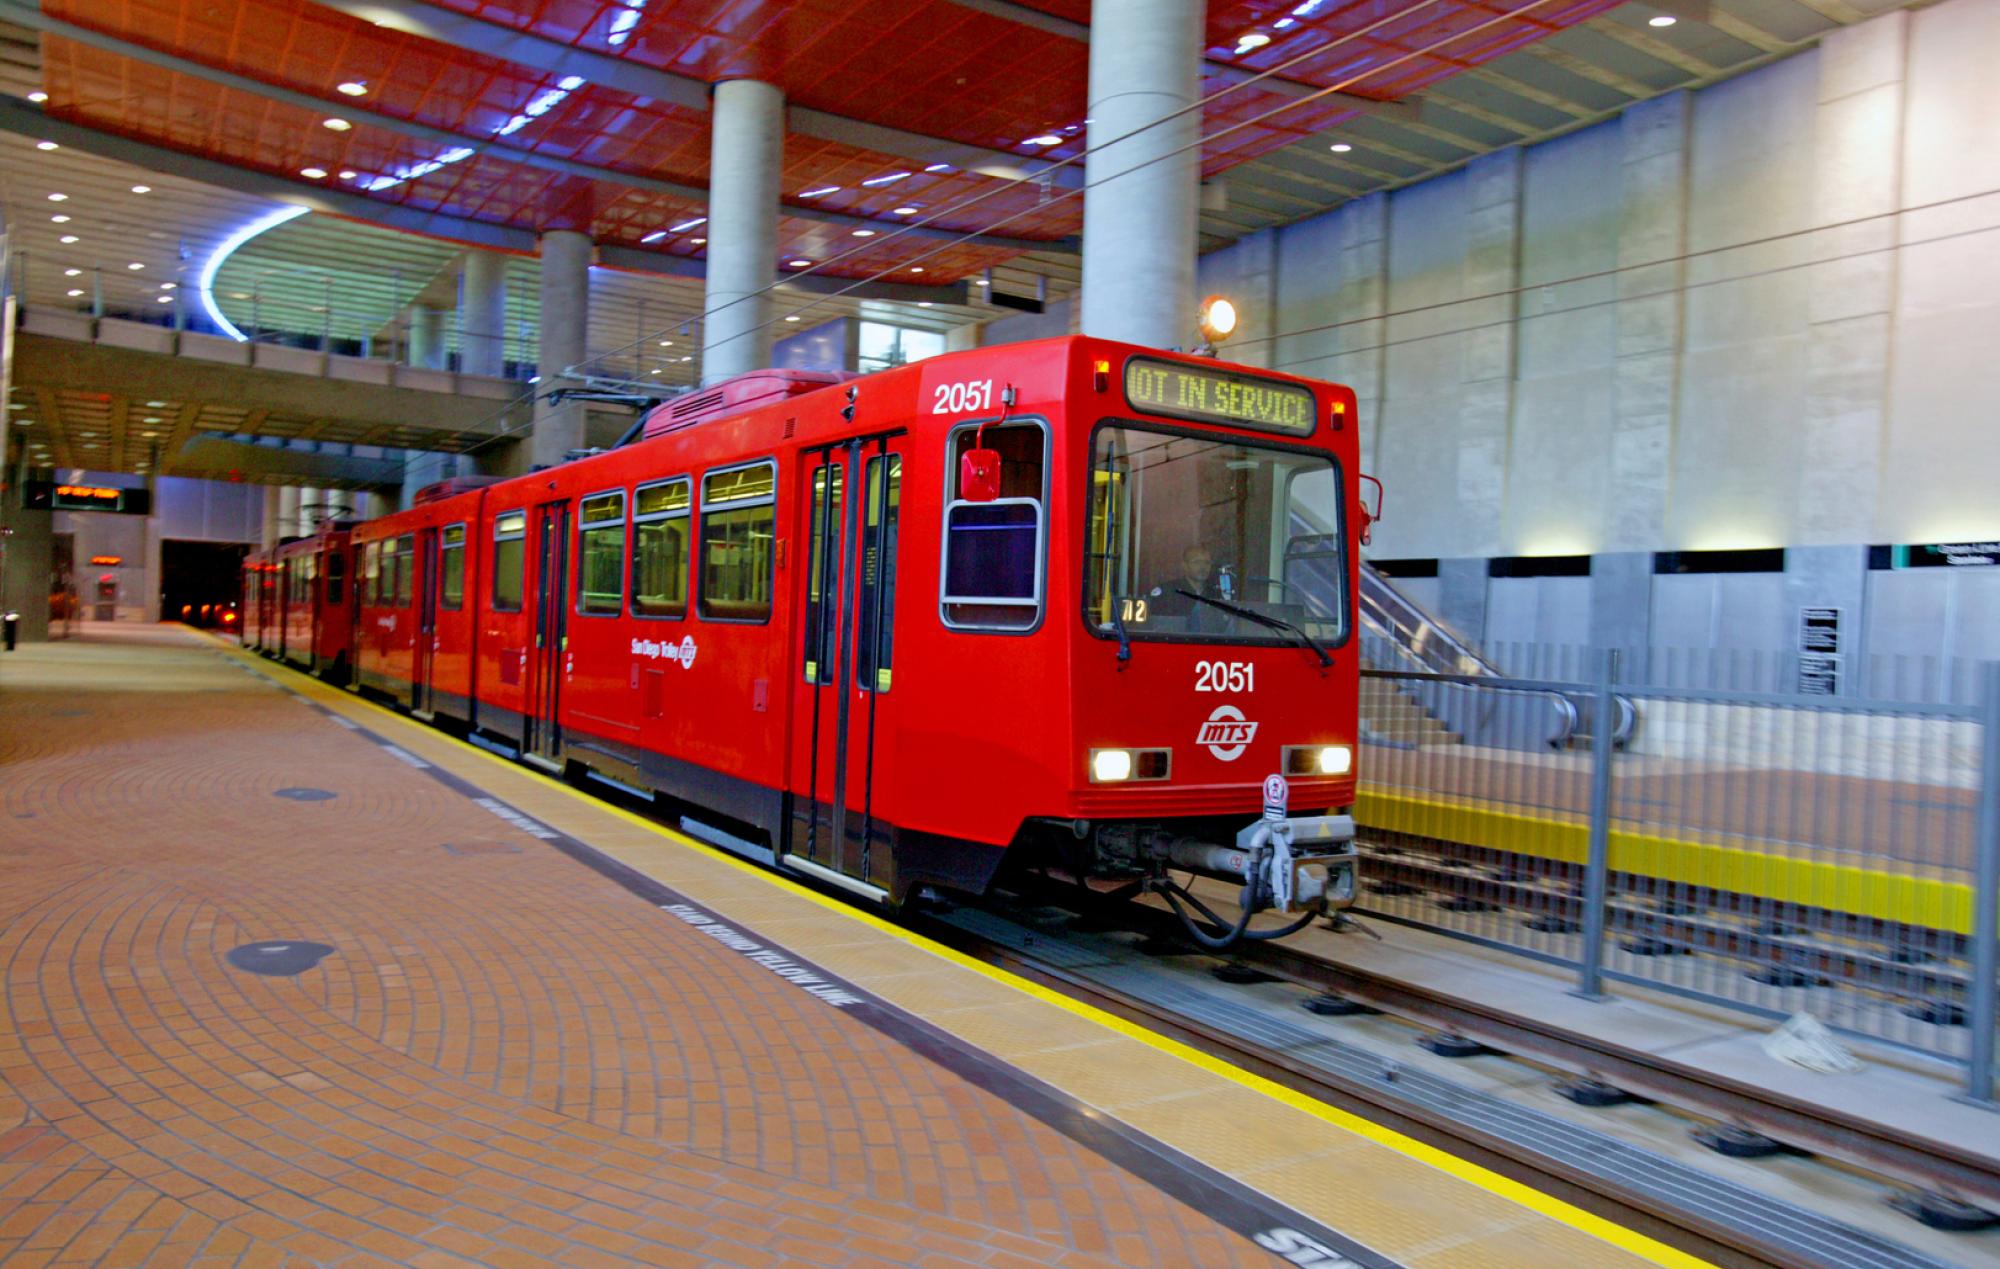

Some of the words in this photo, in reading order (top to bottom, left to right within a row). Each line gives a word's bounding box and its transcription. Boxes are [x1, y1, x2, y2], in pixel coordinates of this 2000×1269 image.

[933, 379, 992, 414] 2051
[1177, 374, 1206, 409] IN
[1215, 381, 1308, 427] SERVICE
[1195, 660, 1254, 692] 2051
[1202, 723, 1252, 742] MTS
[660, 904, 715, 925] STAND
[694, 924, 763, 951] BEHIND
[744, 950, 827, 985] YELLOW
[801, 984, 864, 1006] LINE
